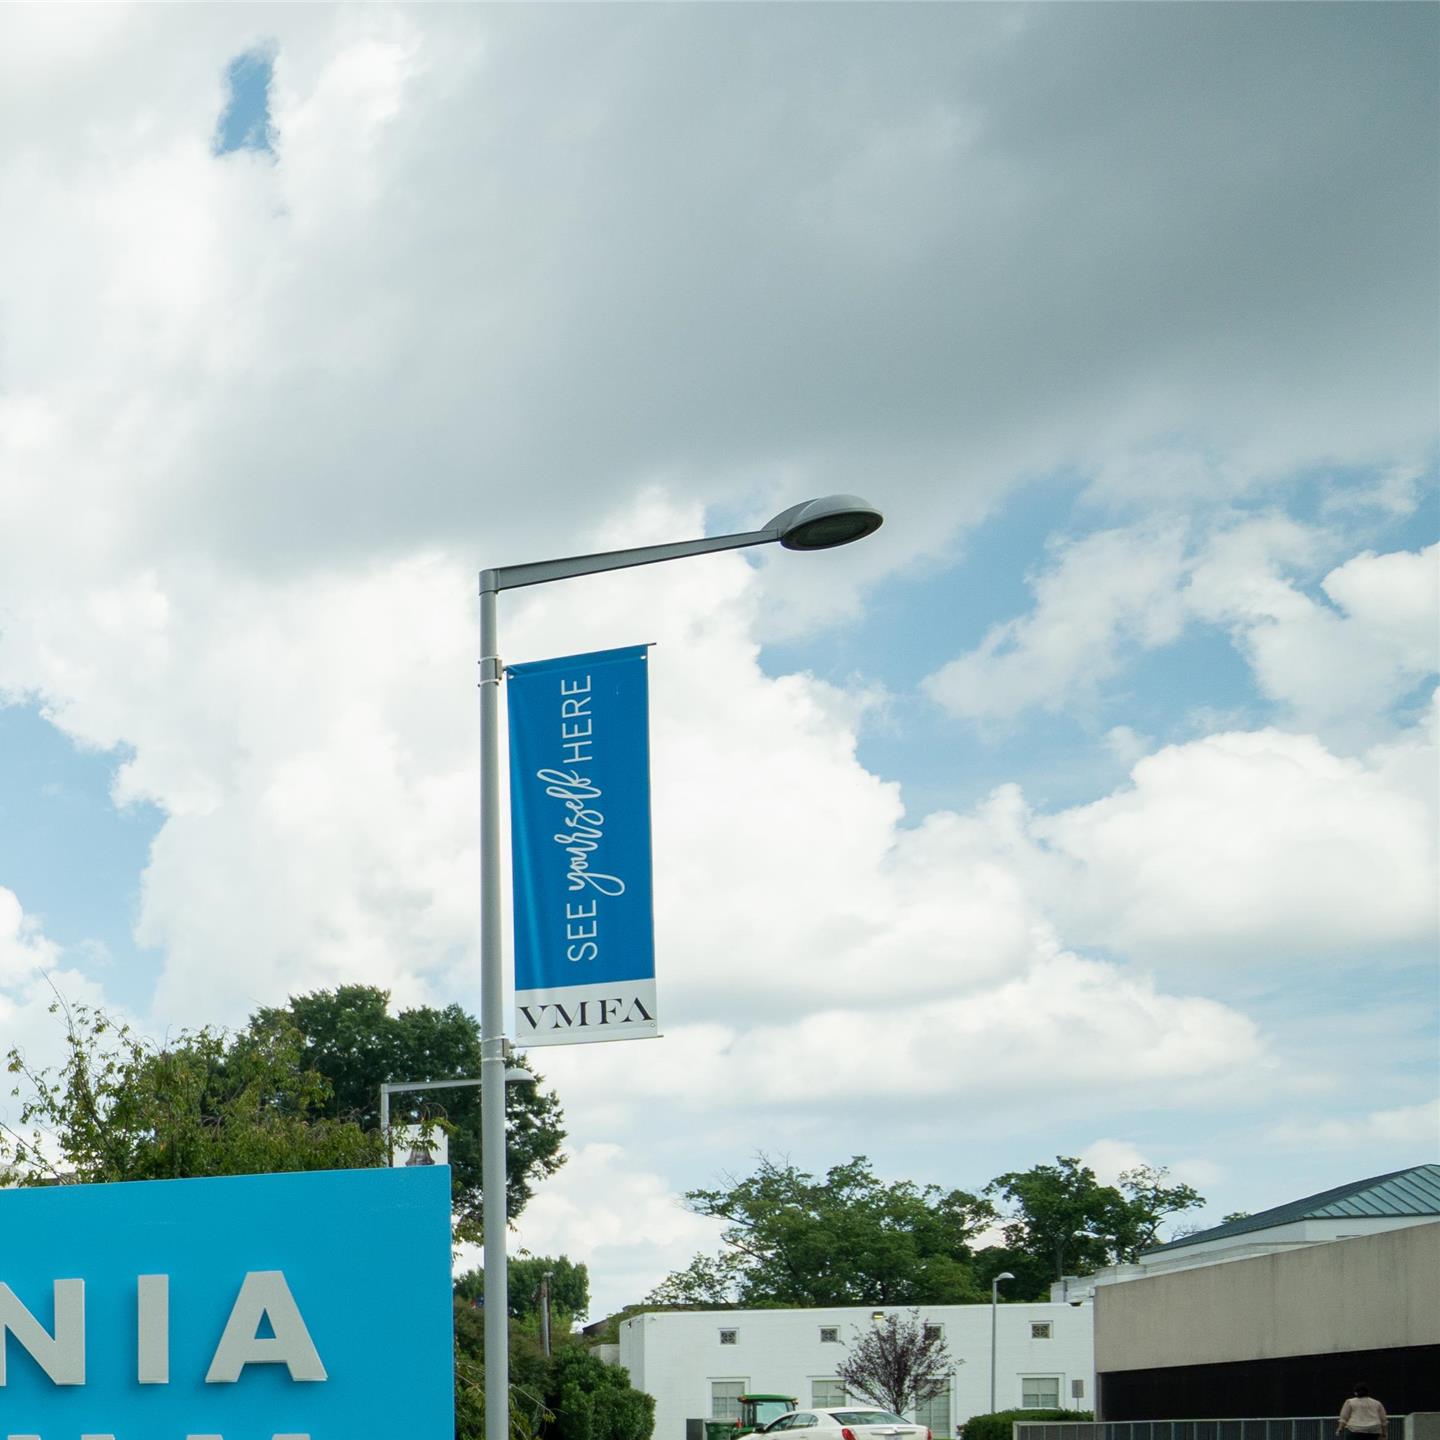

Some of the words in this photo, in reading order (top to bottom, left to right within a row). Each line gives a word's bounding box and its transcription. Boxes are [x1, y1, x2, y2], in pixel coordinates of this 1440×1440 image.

[560, 674, 593, 764] HERE
[536, 768, 625, 896] yourself
[566, 899, 598, 962] SEE
[519, 996, 653, 1031] VMFA
